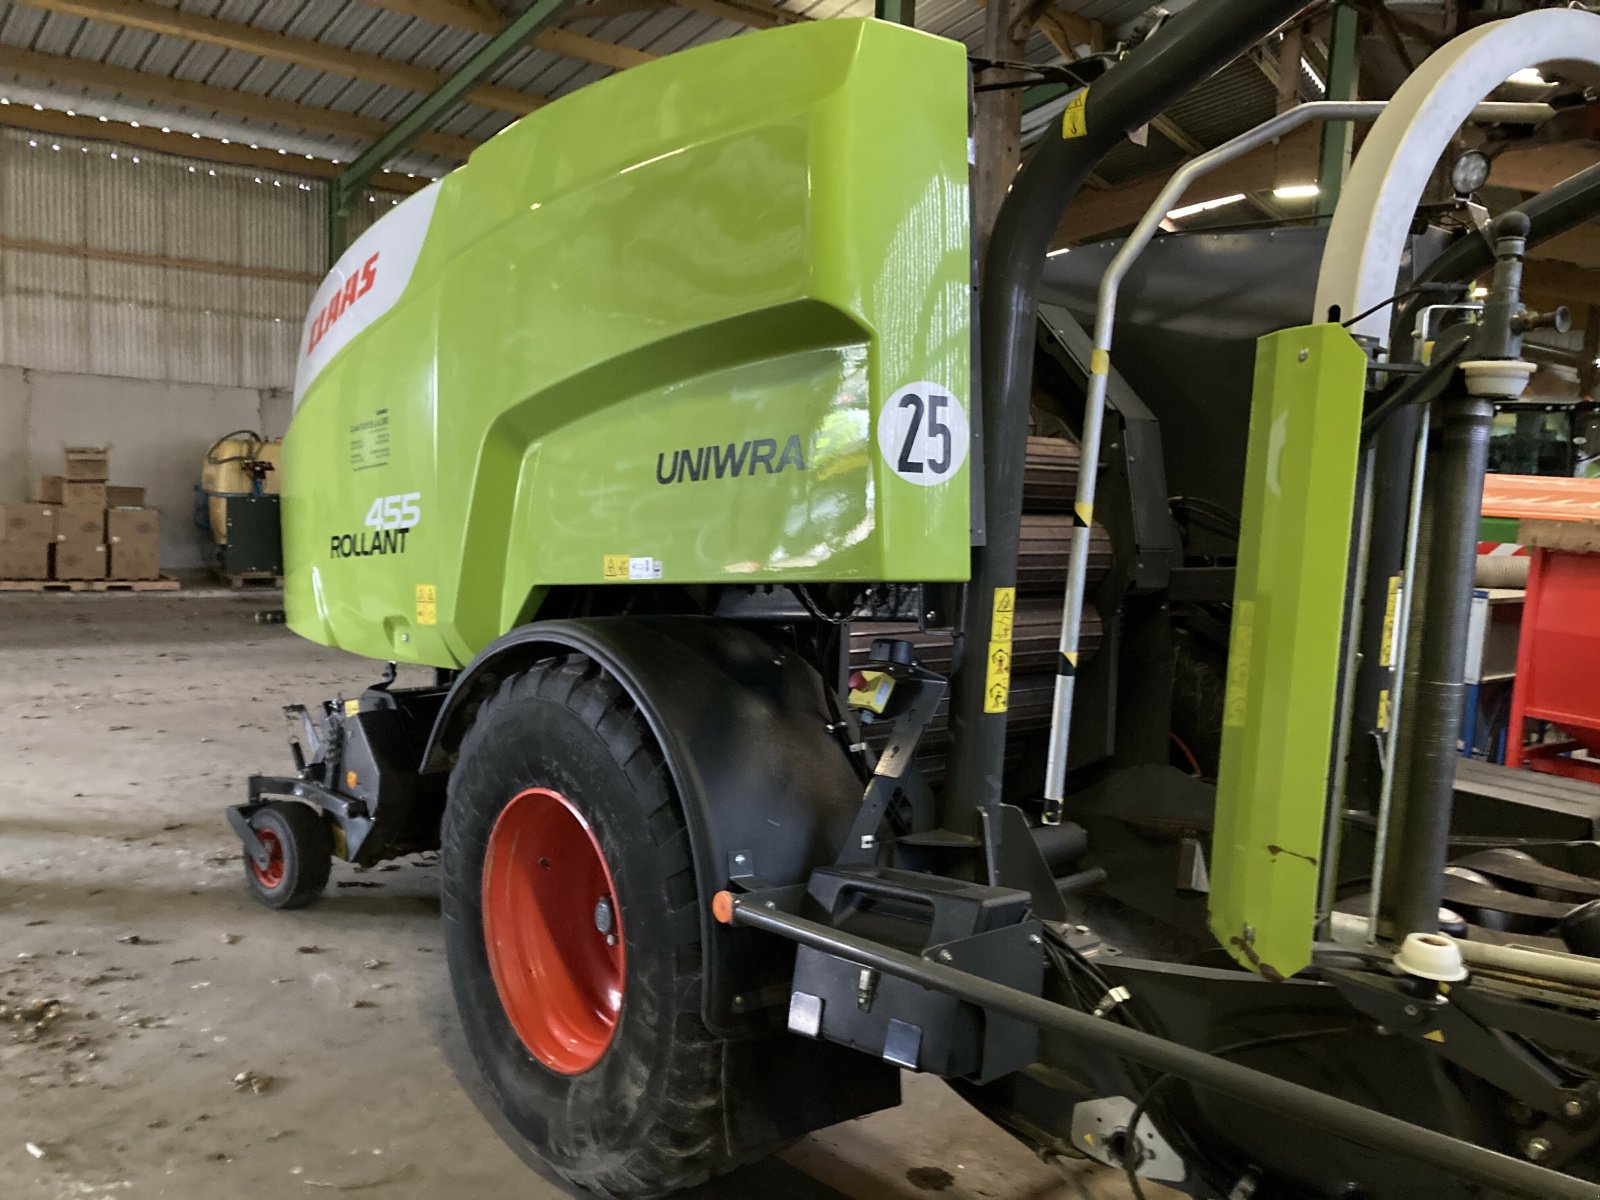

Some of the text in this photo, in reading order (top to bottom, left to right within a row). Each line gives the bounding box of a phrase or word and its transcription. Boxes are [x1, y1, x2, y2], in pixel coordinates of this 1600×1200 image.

[307, 251, 379, 356] CLAAS
[897, 393, 952, 475] 25
[364, 492, 421, 531] 455
[330, 528, 410, 559] ROLLANT
